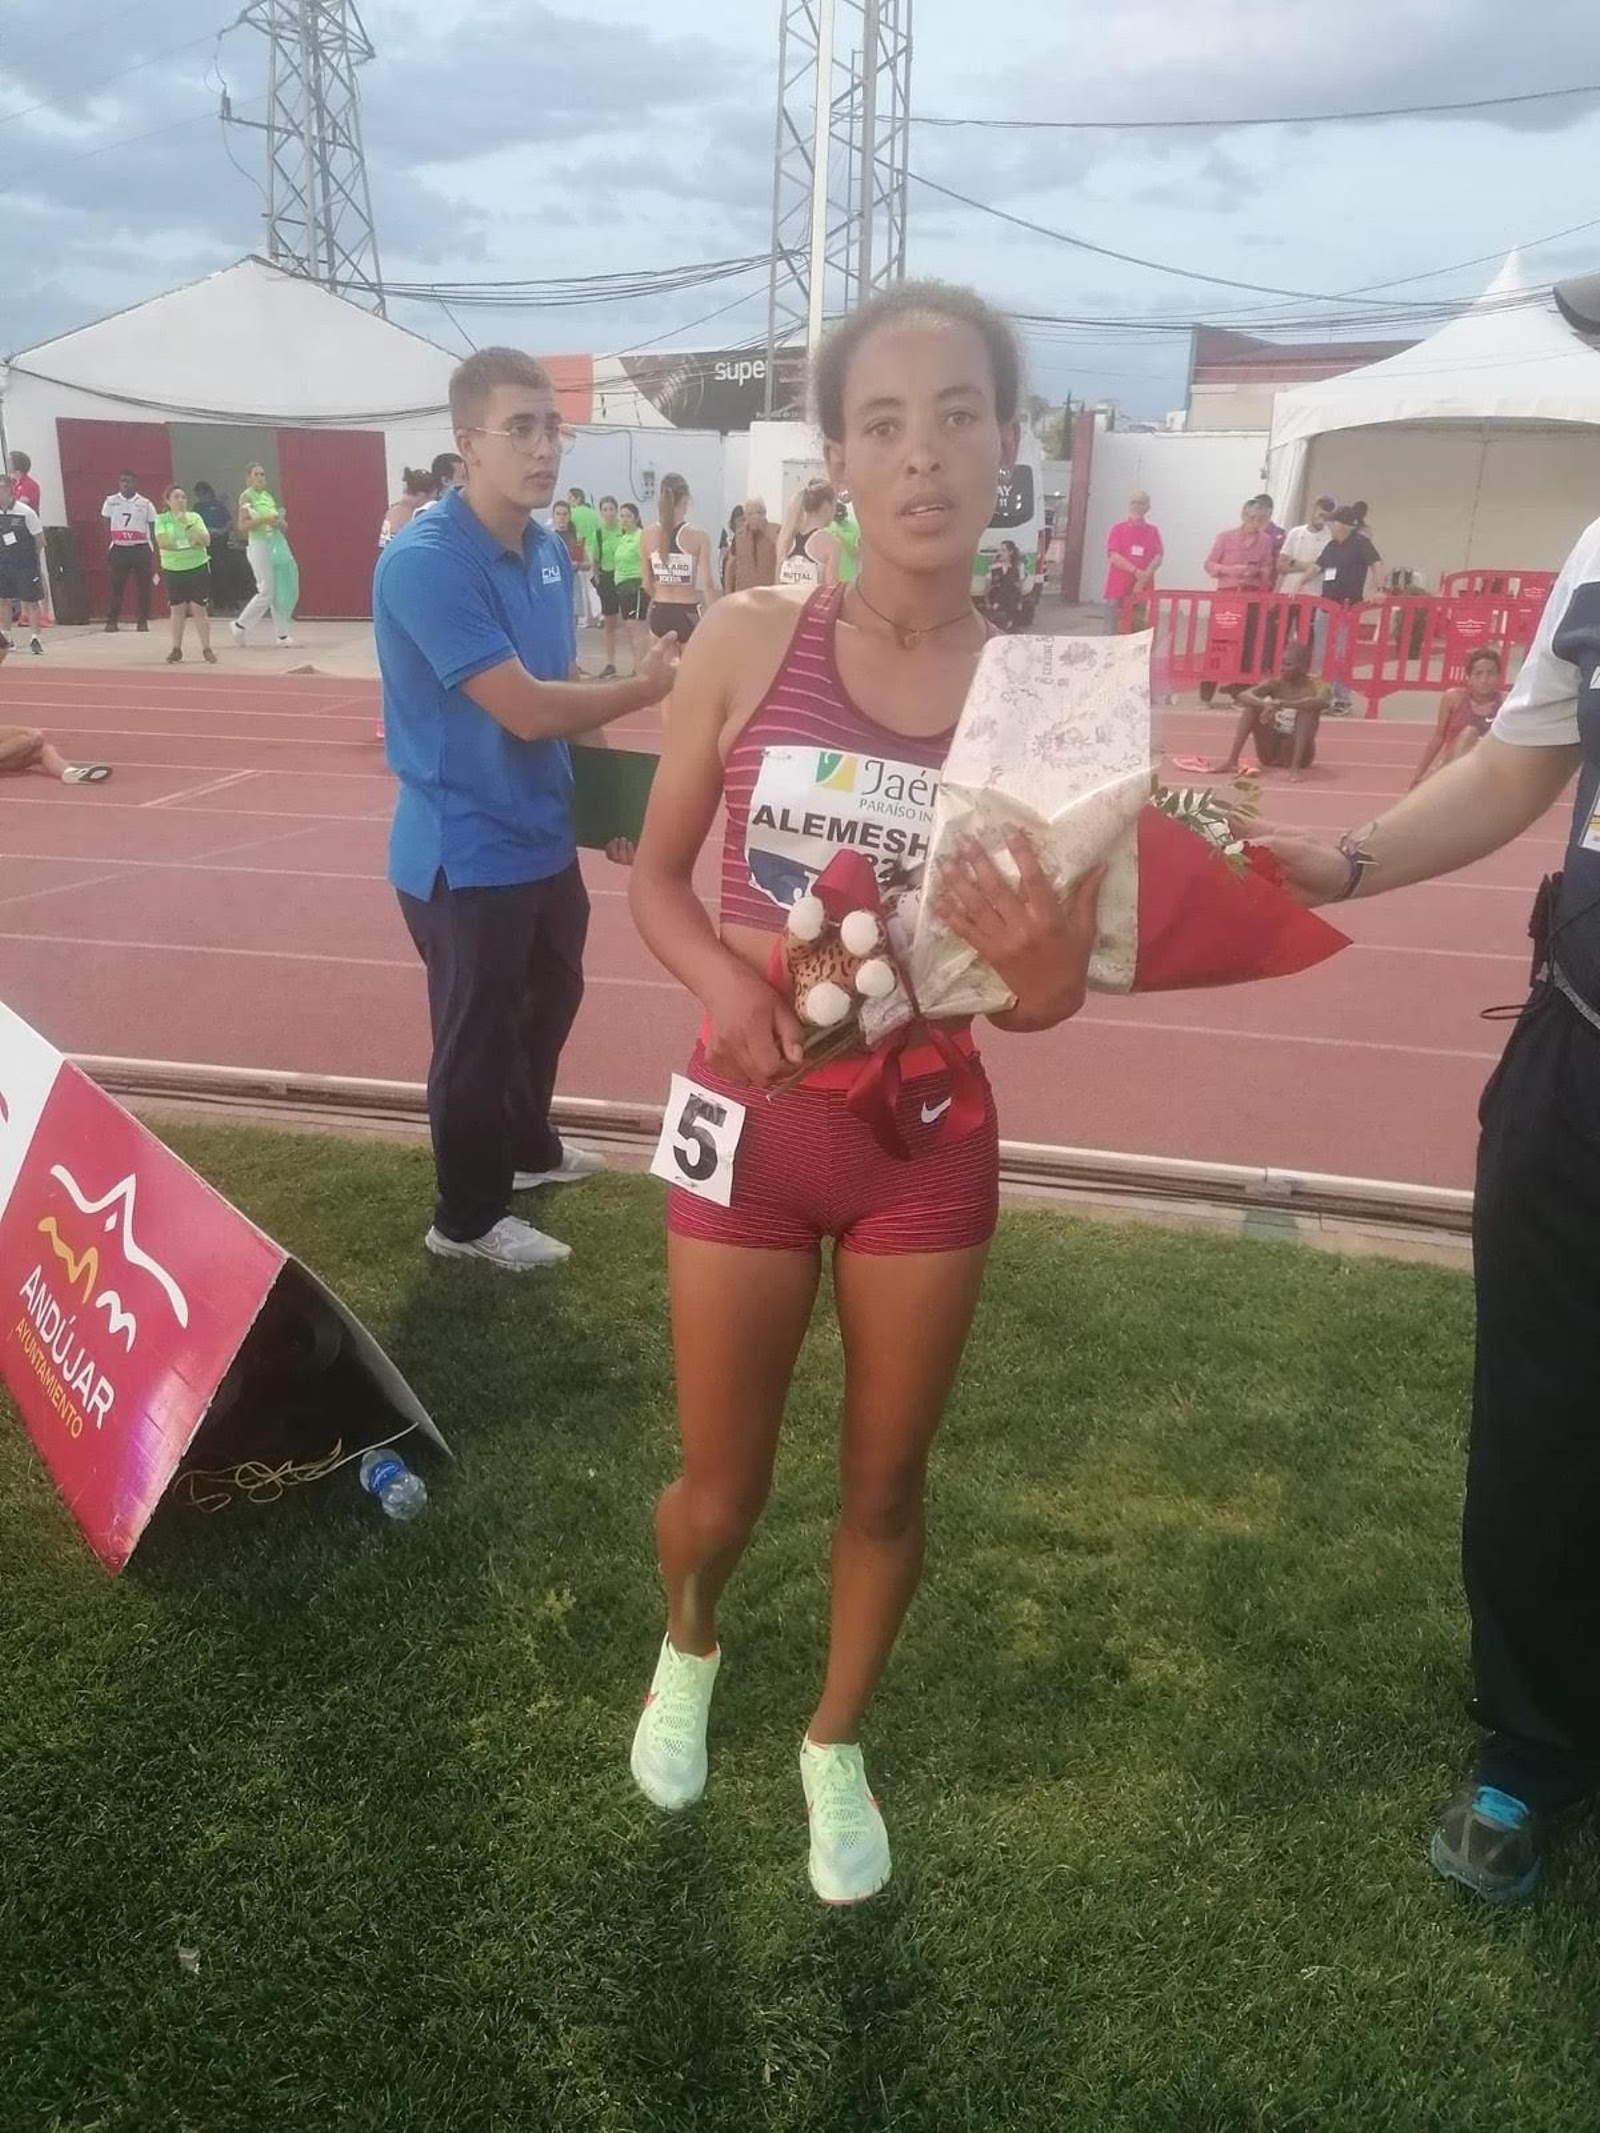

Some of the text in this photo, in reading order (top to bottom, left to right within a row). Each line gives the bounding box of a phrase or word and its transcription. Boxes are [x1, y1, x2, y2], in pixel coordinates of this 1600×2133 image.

[122, 512, 132, 527] 7
[752, 804, 931, 861] ALEMESH
[859, 798, 917, 820] PARAÍSO
[673, 1092, 727, 1181] 5
[15, 1317, 84, 1439] AYUNTAMIENTO
[19, 1264, 115, 1430] ANDÚJAR
